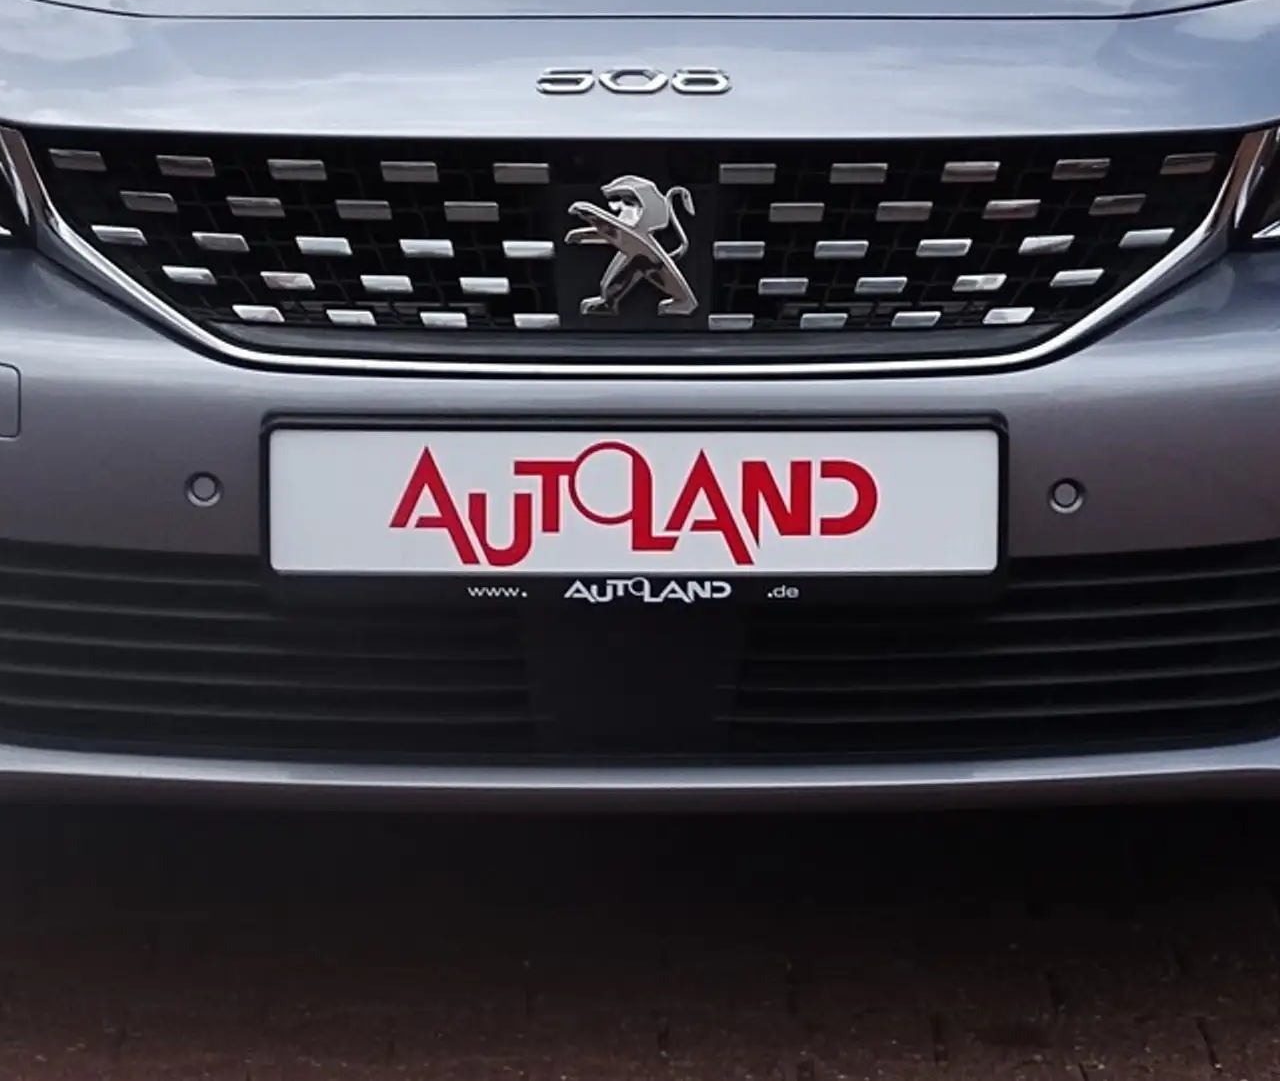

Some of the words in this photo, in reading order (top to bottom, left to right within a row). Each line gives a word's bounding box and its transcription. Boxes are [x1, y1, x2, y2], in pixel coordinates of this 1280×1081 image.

[535, 66, 733, 95] 508
[389, 441, 879, 567] AUTOLAND
[467, 585, 528, 598] www.
[563, 576, 732, 603] AUTOLAND
[766, 584, 800, 599] .de
